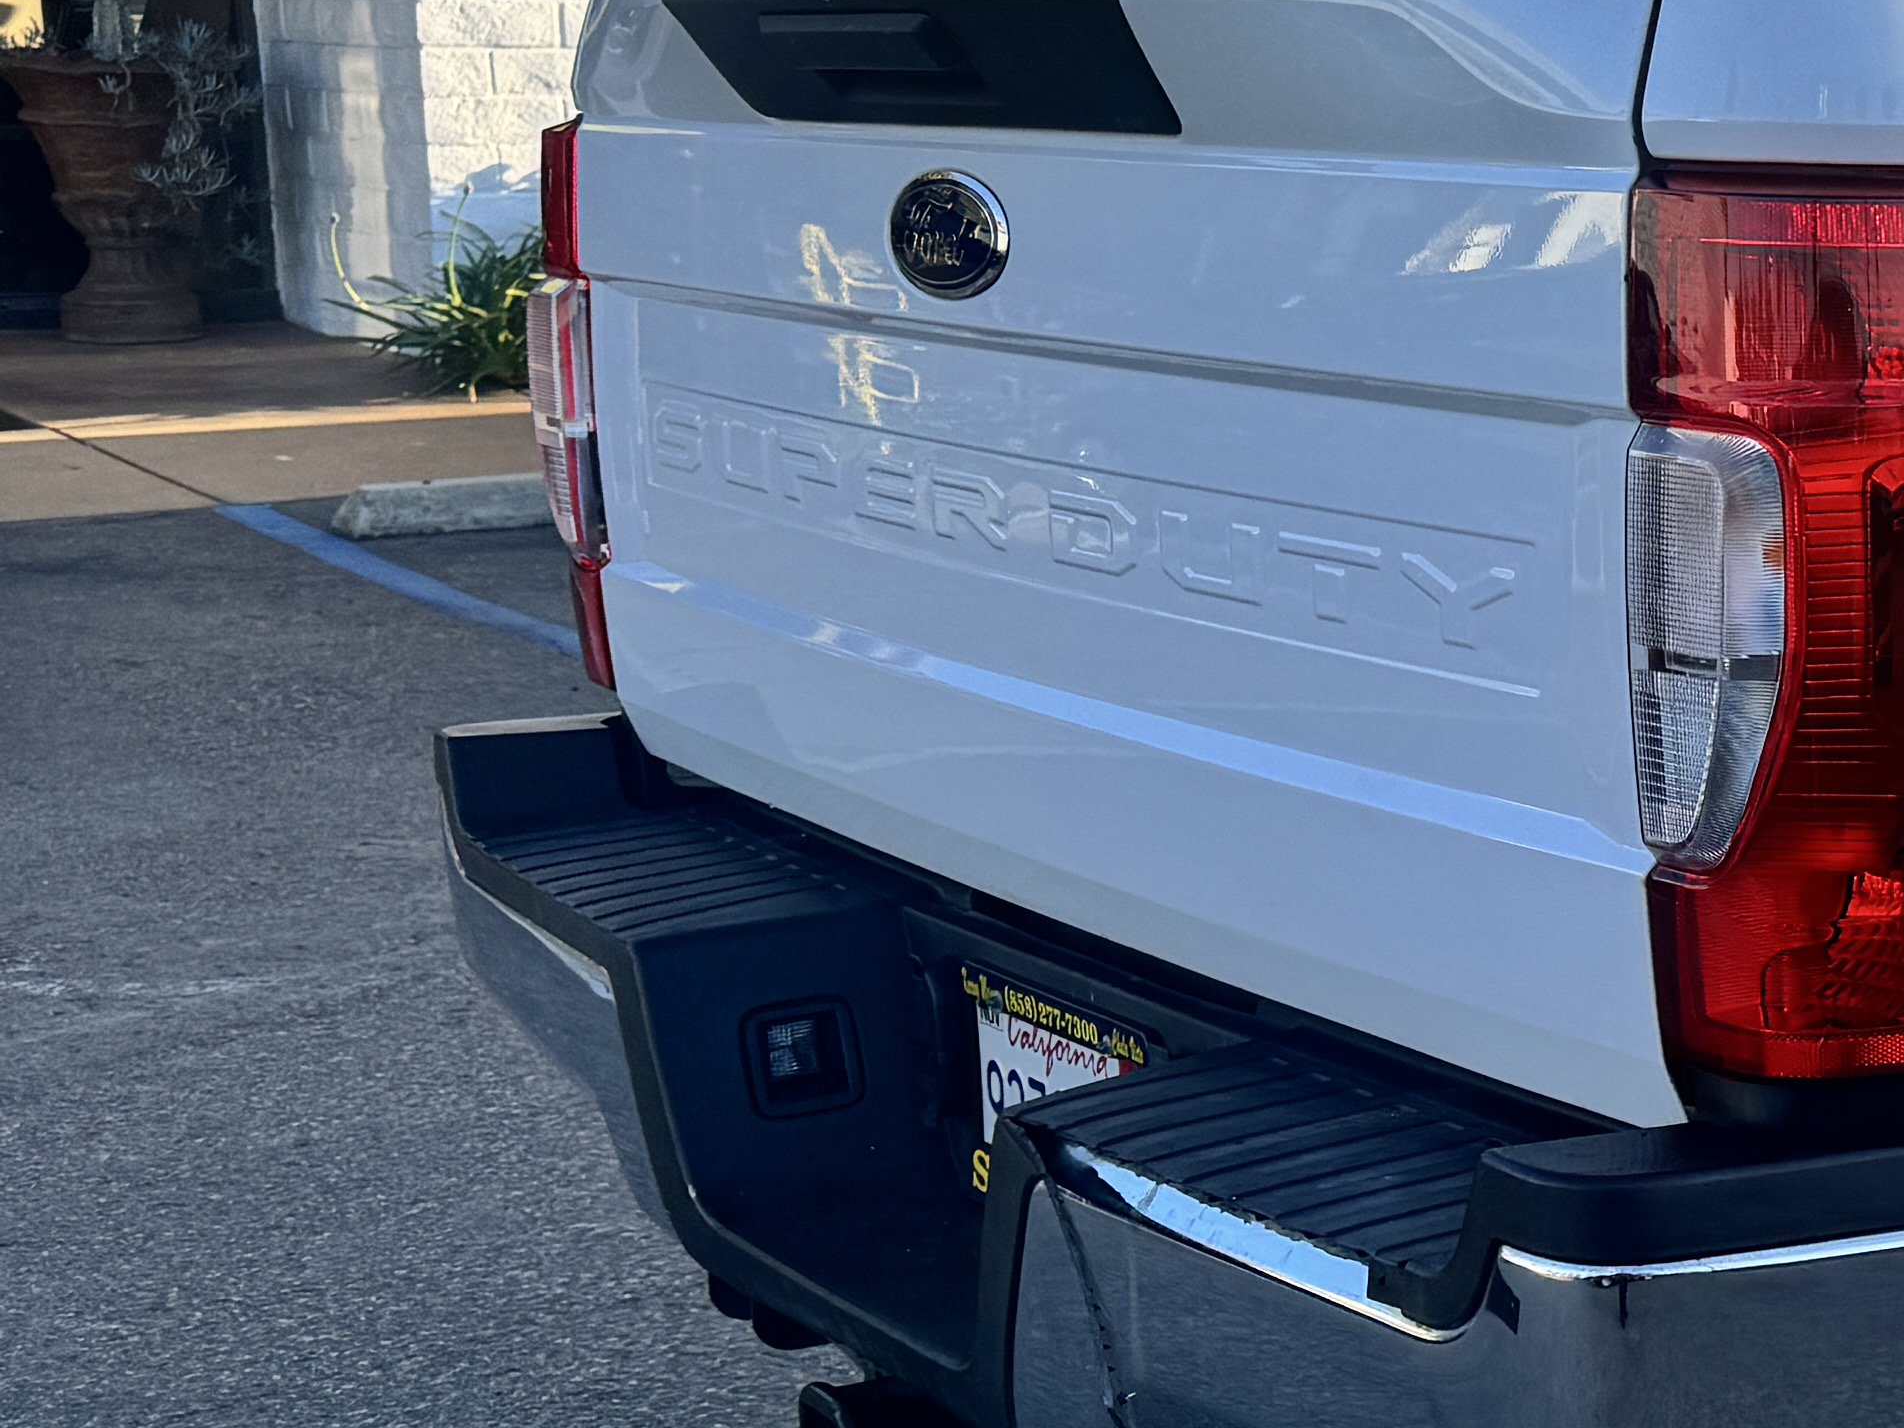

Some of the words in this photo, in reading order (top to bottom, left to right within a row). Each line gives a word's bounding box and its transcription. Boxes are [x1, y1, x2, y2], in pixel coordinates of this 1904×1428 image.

[650, 398, 1008, 552] SUPER
[1049, 487, 1516, 650] DUTY
[1004, 985, 1038, 1023] (858)
[1038, 1002, 1099, 1045] 277-7300
[1007, 1015, 1109, 1079] California
